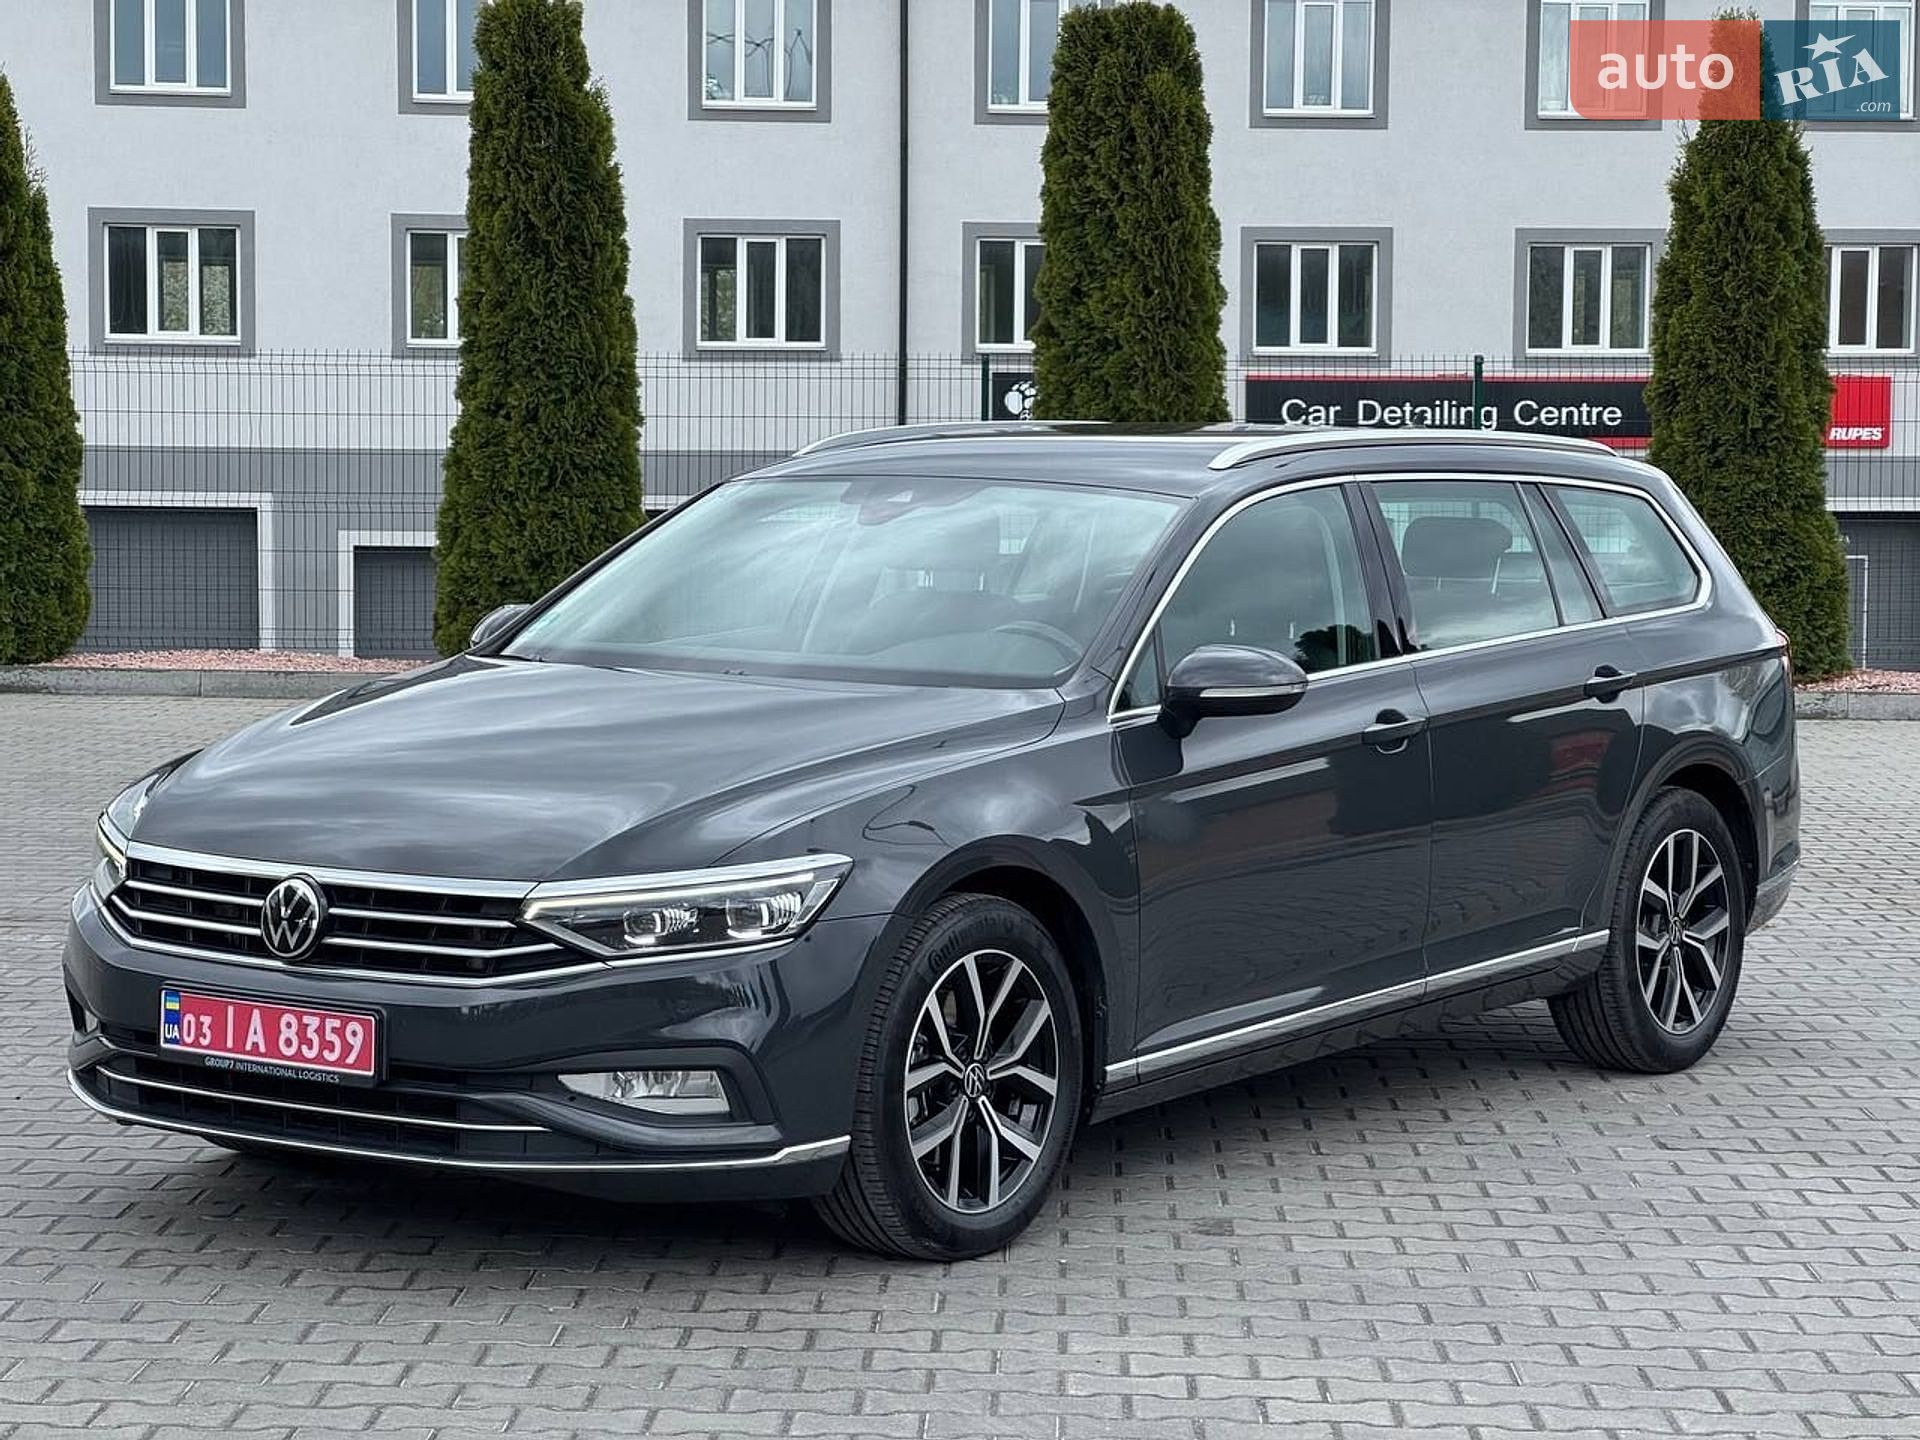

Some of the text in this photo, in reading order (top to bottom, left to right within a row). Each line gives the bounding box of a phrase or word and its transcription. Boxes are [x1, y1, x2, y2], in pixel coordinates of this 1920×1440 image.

[1281, 399, 1623, 432] Car Detailing Centre
[1829, 427, 1883, 441] RUPES
[164, 1023, 180, 1040] UA
[278, 1013, 365, 1065] 8359
[235, 1061, 297, 1079] INTERNATIONAL
[298, 1070, 340, 1084] LOGISTICS
